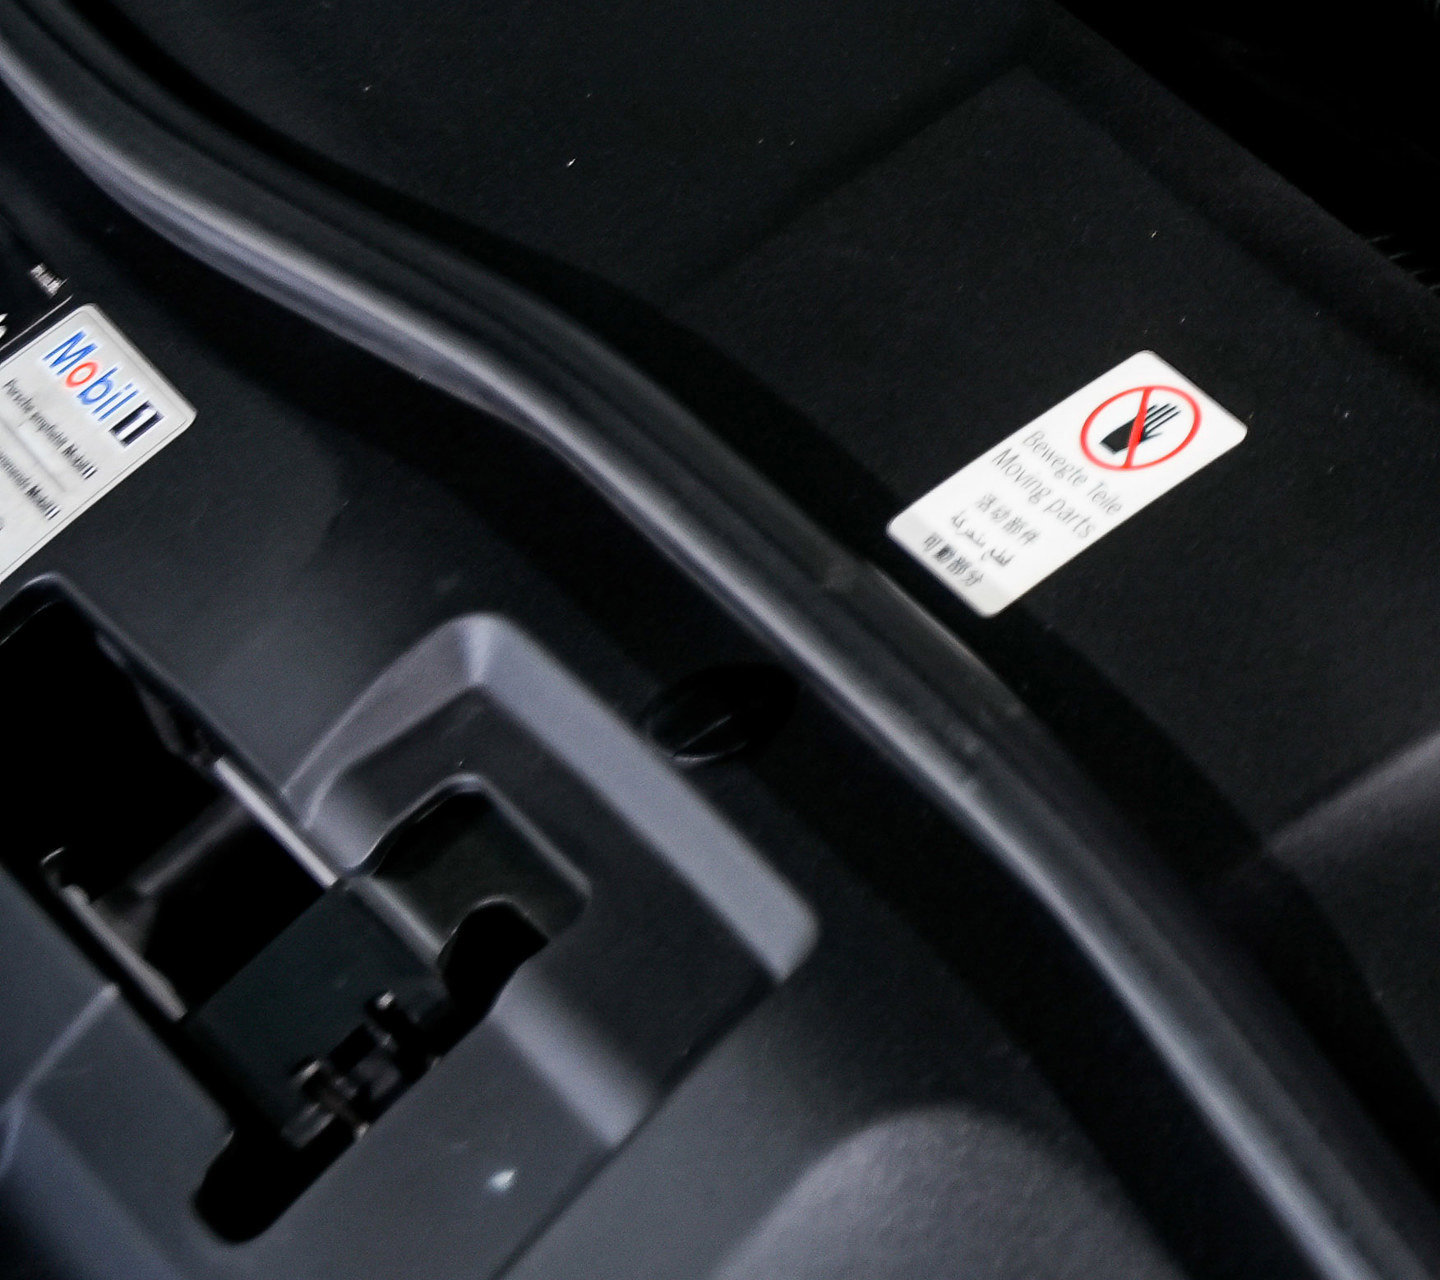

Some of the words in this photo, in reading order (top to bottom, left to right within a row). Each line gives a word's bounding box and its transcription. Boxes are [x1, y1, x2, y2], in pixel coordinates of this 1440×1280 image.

[40, 328, 140, 423] Mobil
[991, 447, 1053, 505] Moving
[1042, 497, 1096, 539] parts
[1022, 429, 1089, 487] Bewegte
[1086, 481, 1123, 515] Teile
